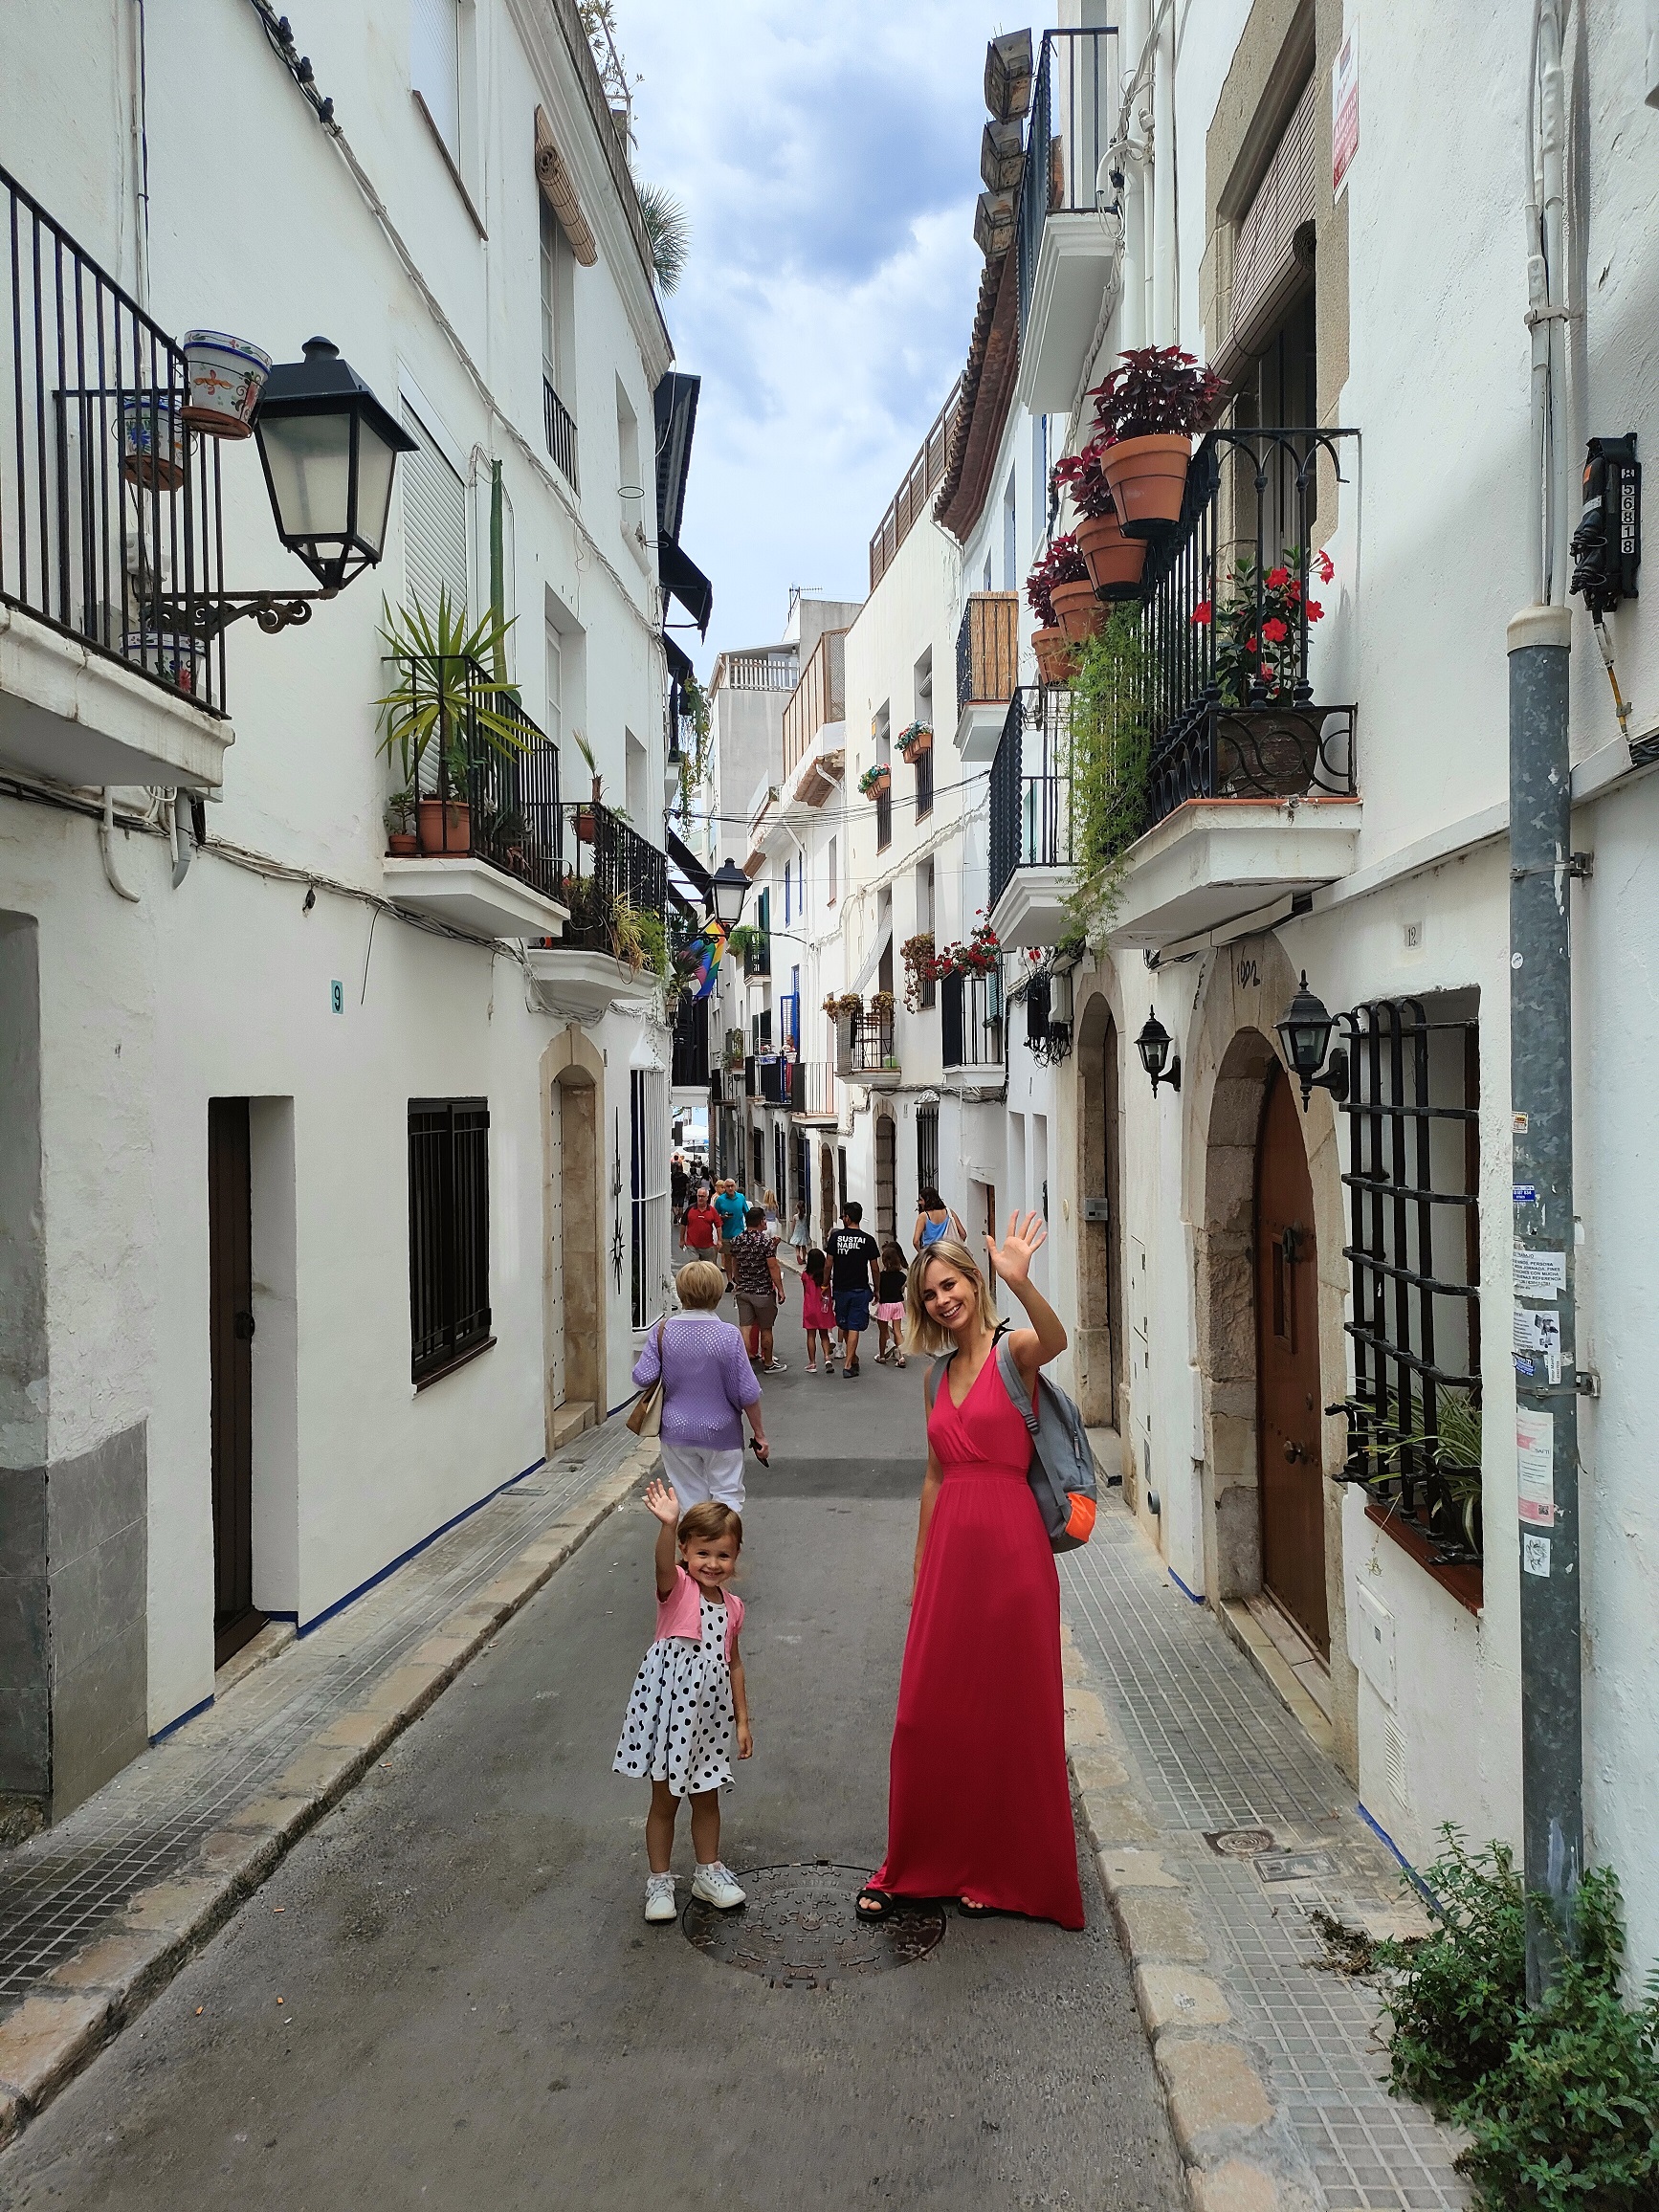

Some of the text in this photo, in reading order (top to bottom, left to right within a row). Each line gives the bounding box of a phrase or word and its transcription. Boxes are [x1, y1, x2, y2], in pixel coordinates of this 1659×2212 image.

[1408, 927, 1416, 946] 12
[335, 985, 341, 1011] 9
[837, 1235, 866, 1244] SUSTAI
